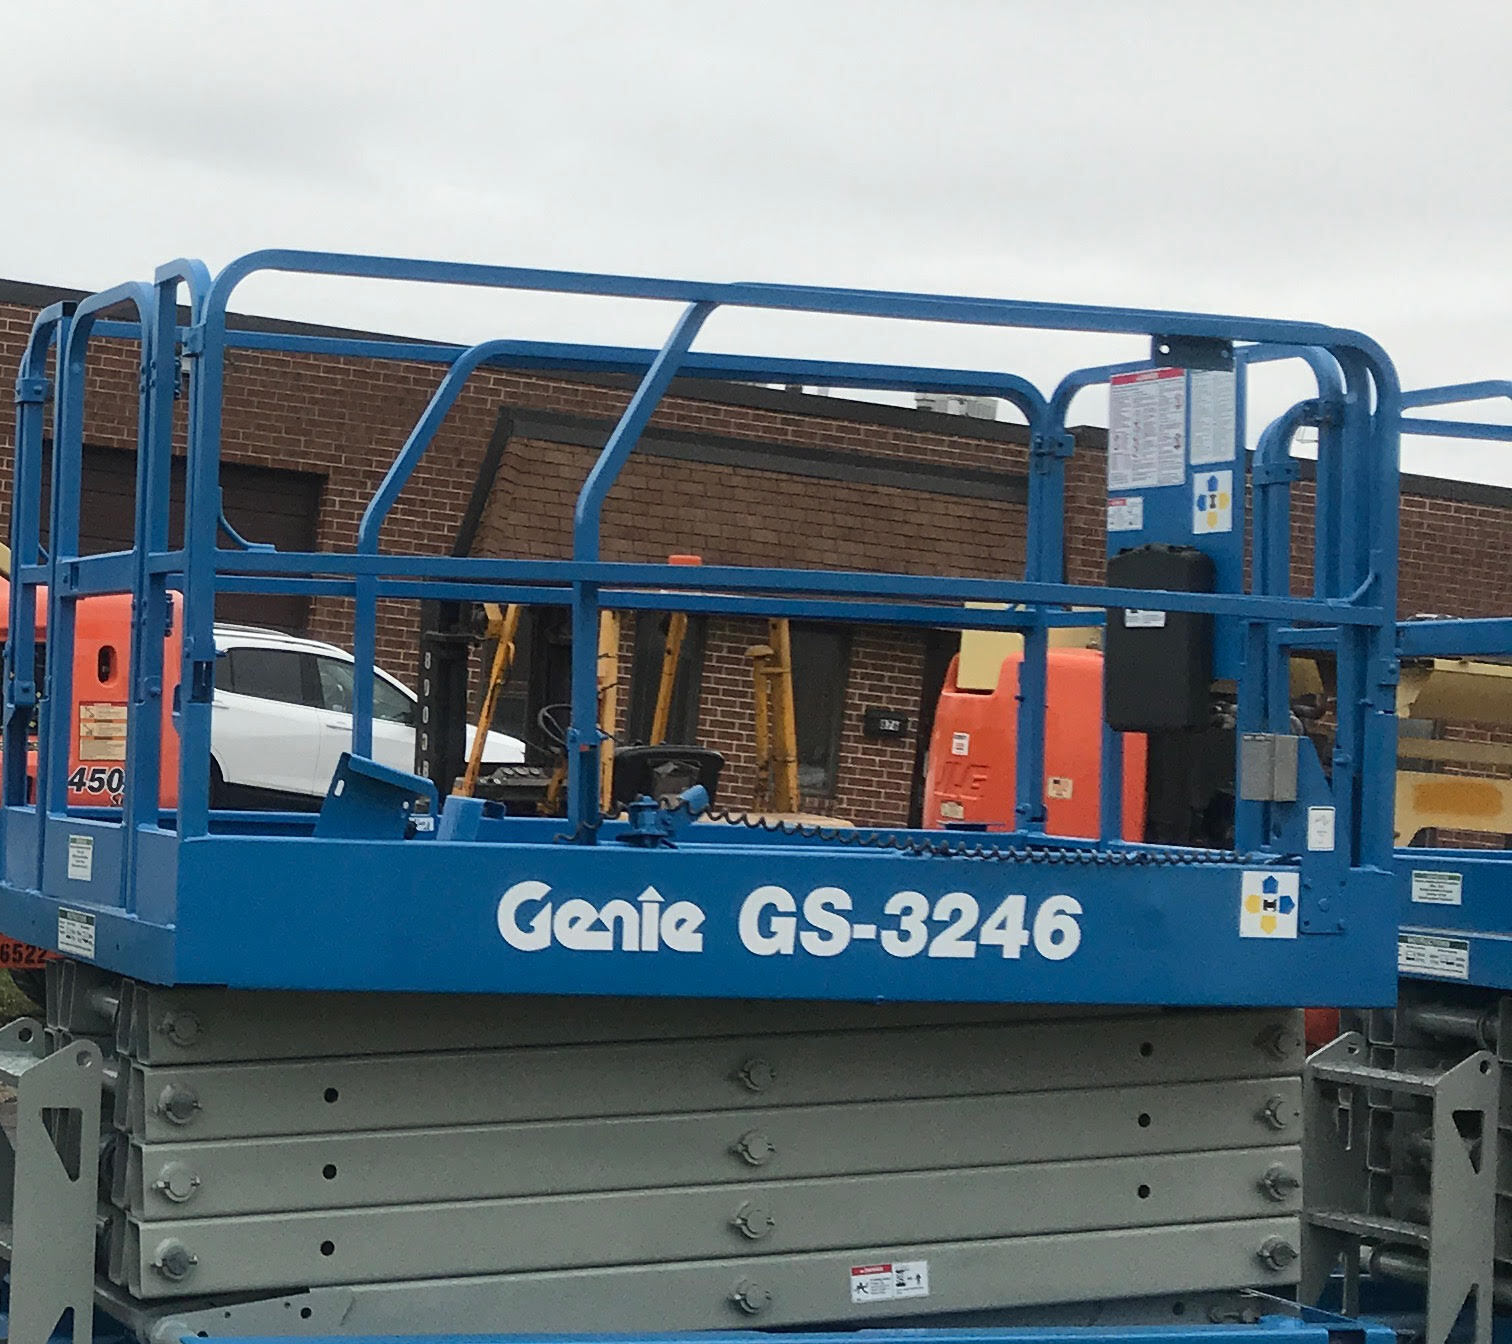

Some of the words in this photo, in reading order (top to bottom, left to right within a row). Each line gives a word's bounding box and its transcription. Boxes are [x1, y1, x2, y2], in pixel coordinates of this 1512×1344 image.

[68, 765, 125, 795] 450
[497, 880, 706, 952] Genie
[738, 885, 1083, 961] GS-3246
